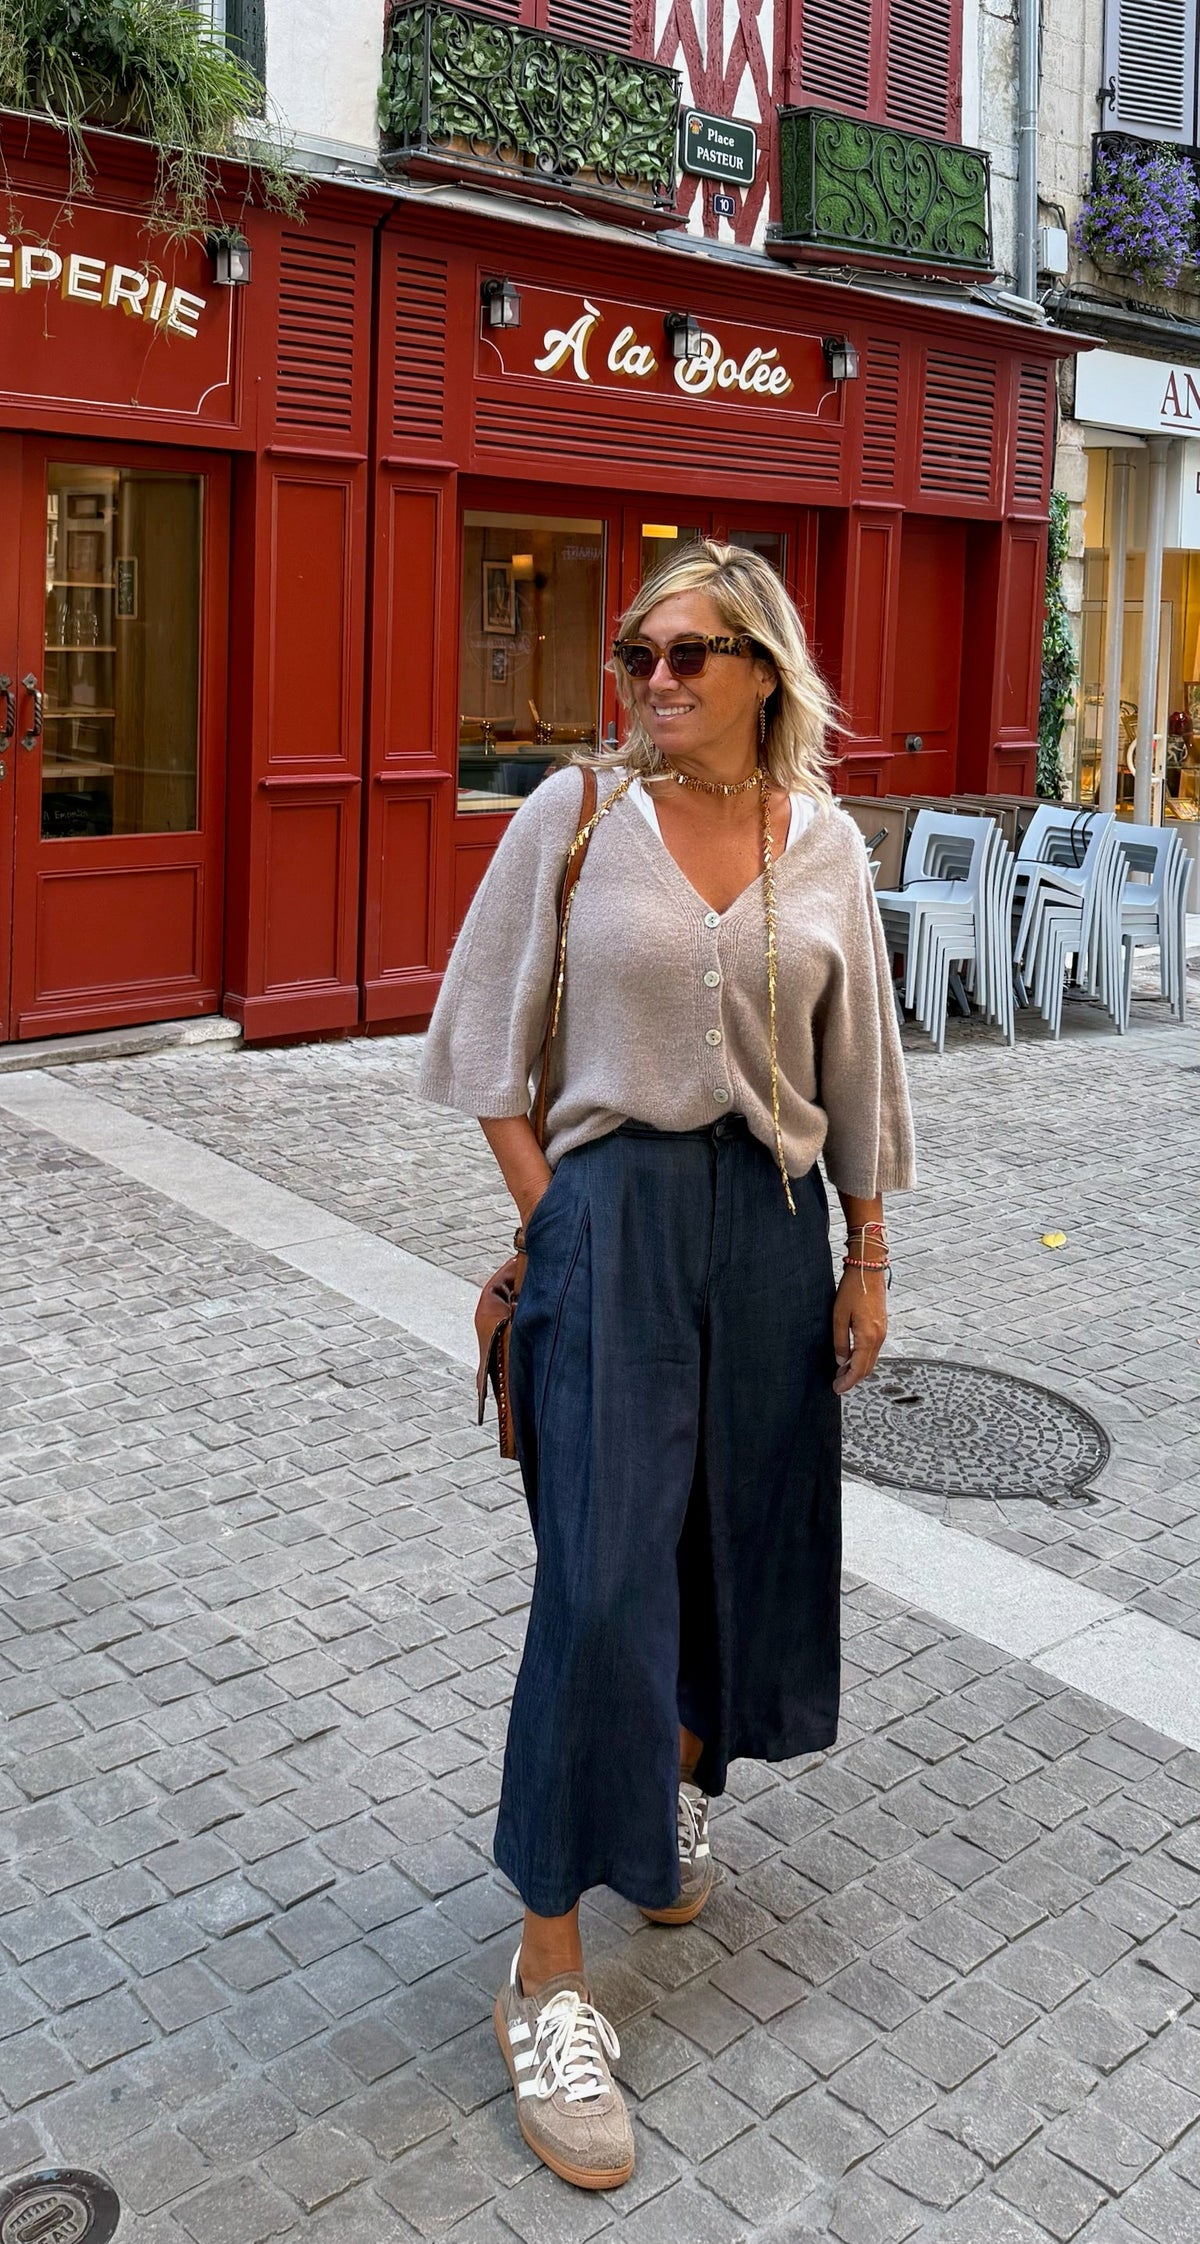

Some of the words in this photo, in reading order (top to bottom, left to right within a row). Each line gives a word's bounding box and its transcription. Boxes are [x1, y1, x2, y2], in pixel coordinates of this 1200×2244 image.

[707, 128, 735, 147] Place
[696, 146, 744, 171] PASTEUR
[719, 198, 730, 212] 10
[534, 299, 601, 381] À
[607, 326, 656, 376] la
[674, 332, 792, 395] Bolée
